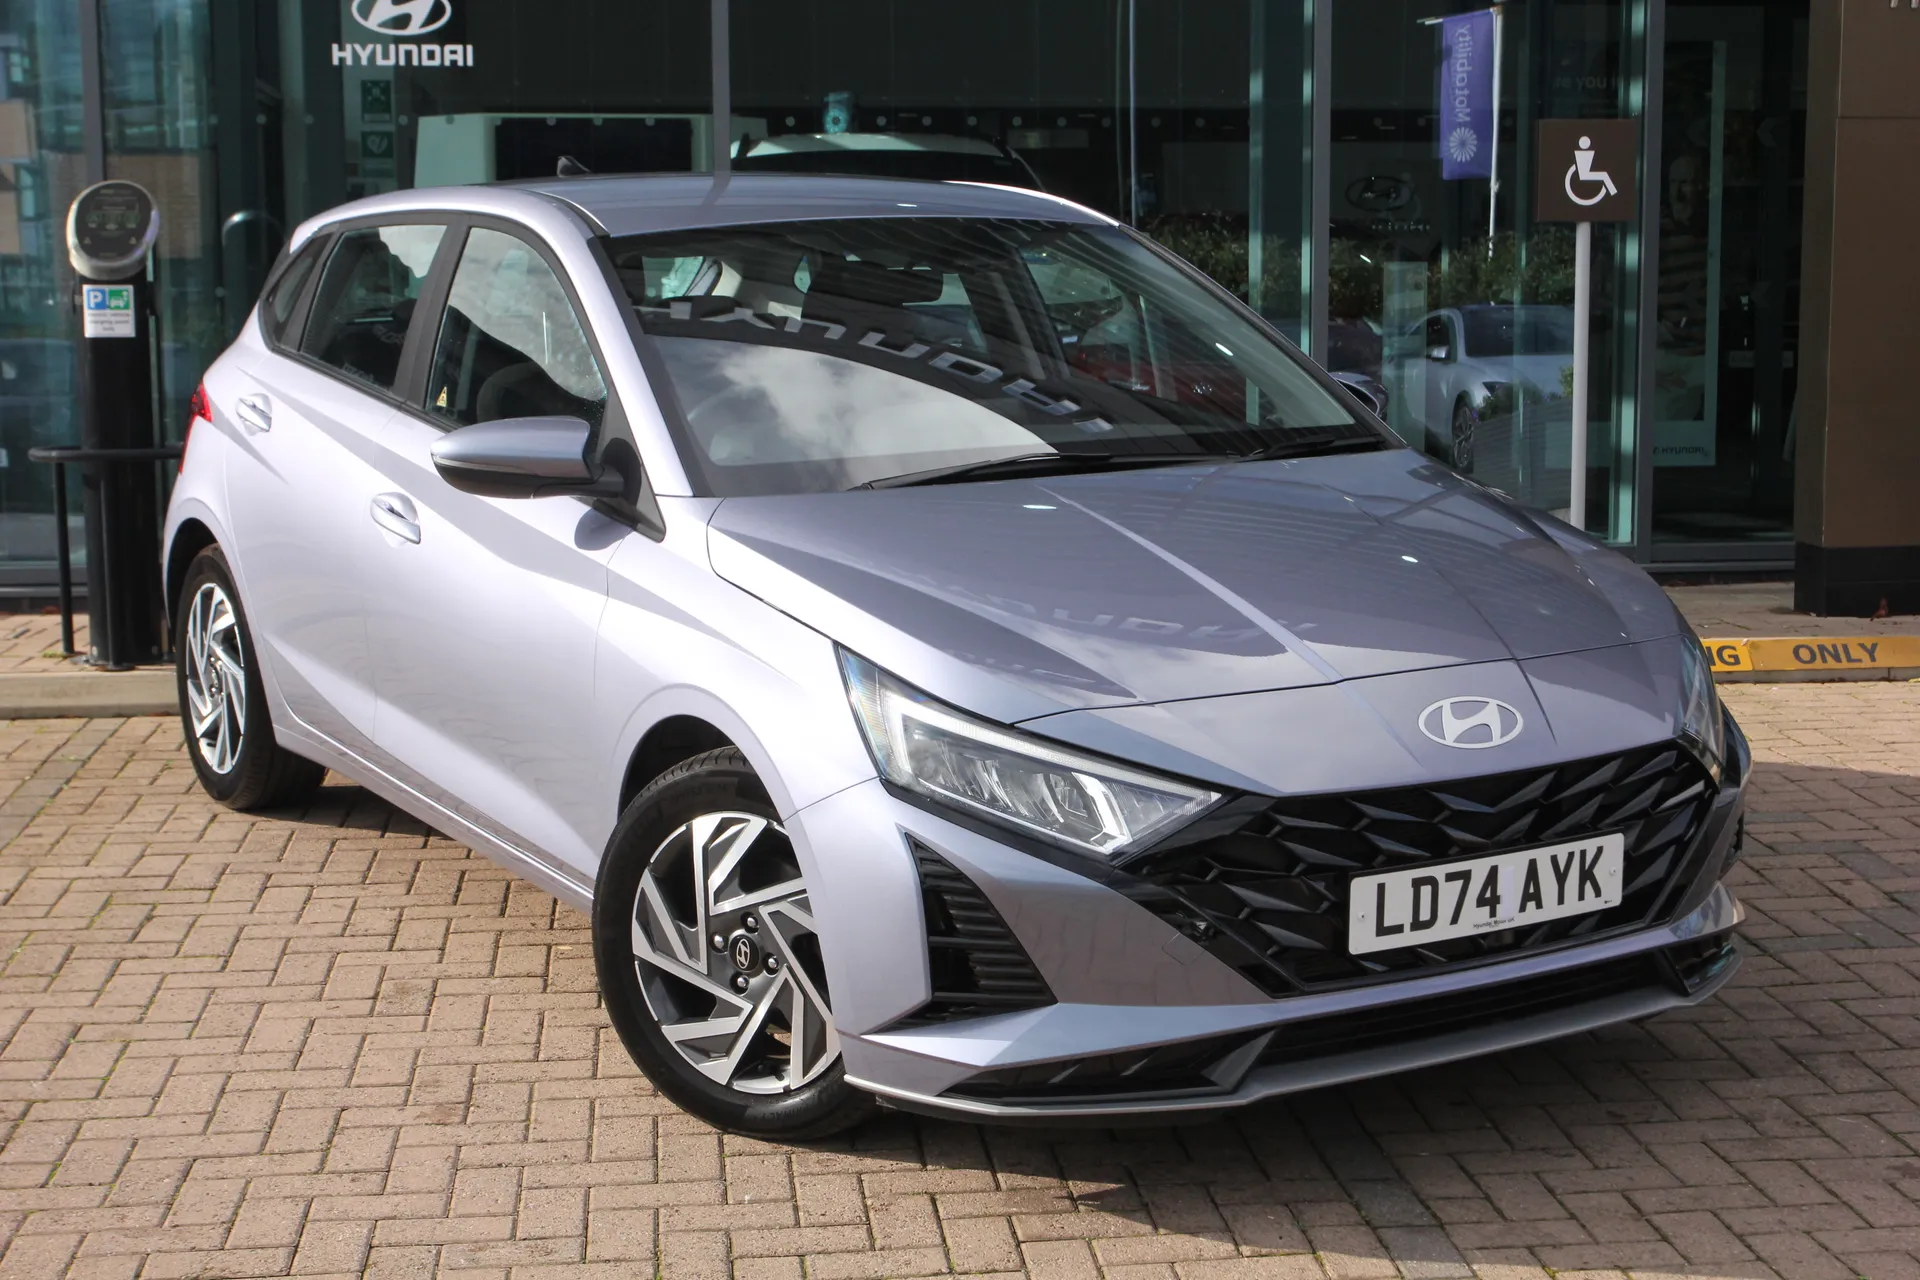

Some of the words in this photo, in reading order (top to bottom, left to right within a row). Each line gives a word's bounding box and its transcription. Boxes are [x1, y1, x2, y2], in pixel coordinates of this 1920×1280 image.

[331, 43, 474, 67] HYUNDAI
[90, 291, 103, 308] P
[1661, 446, 1704, 455] HYUNDAI
[1792, 642, 1878, 664] ONLY
[1375, 864, 1502, 938] LD74
[1518, 845, 1604, 914] AYK
